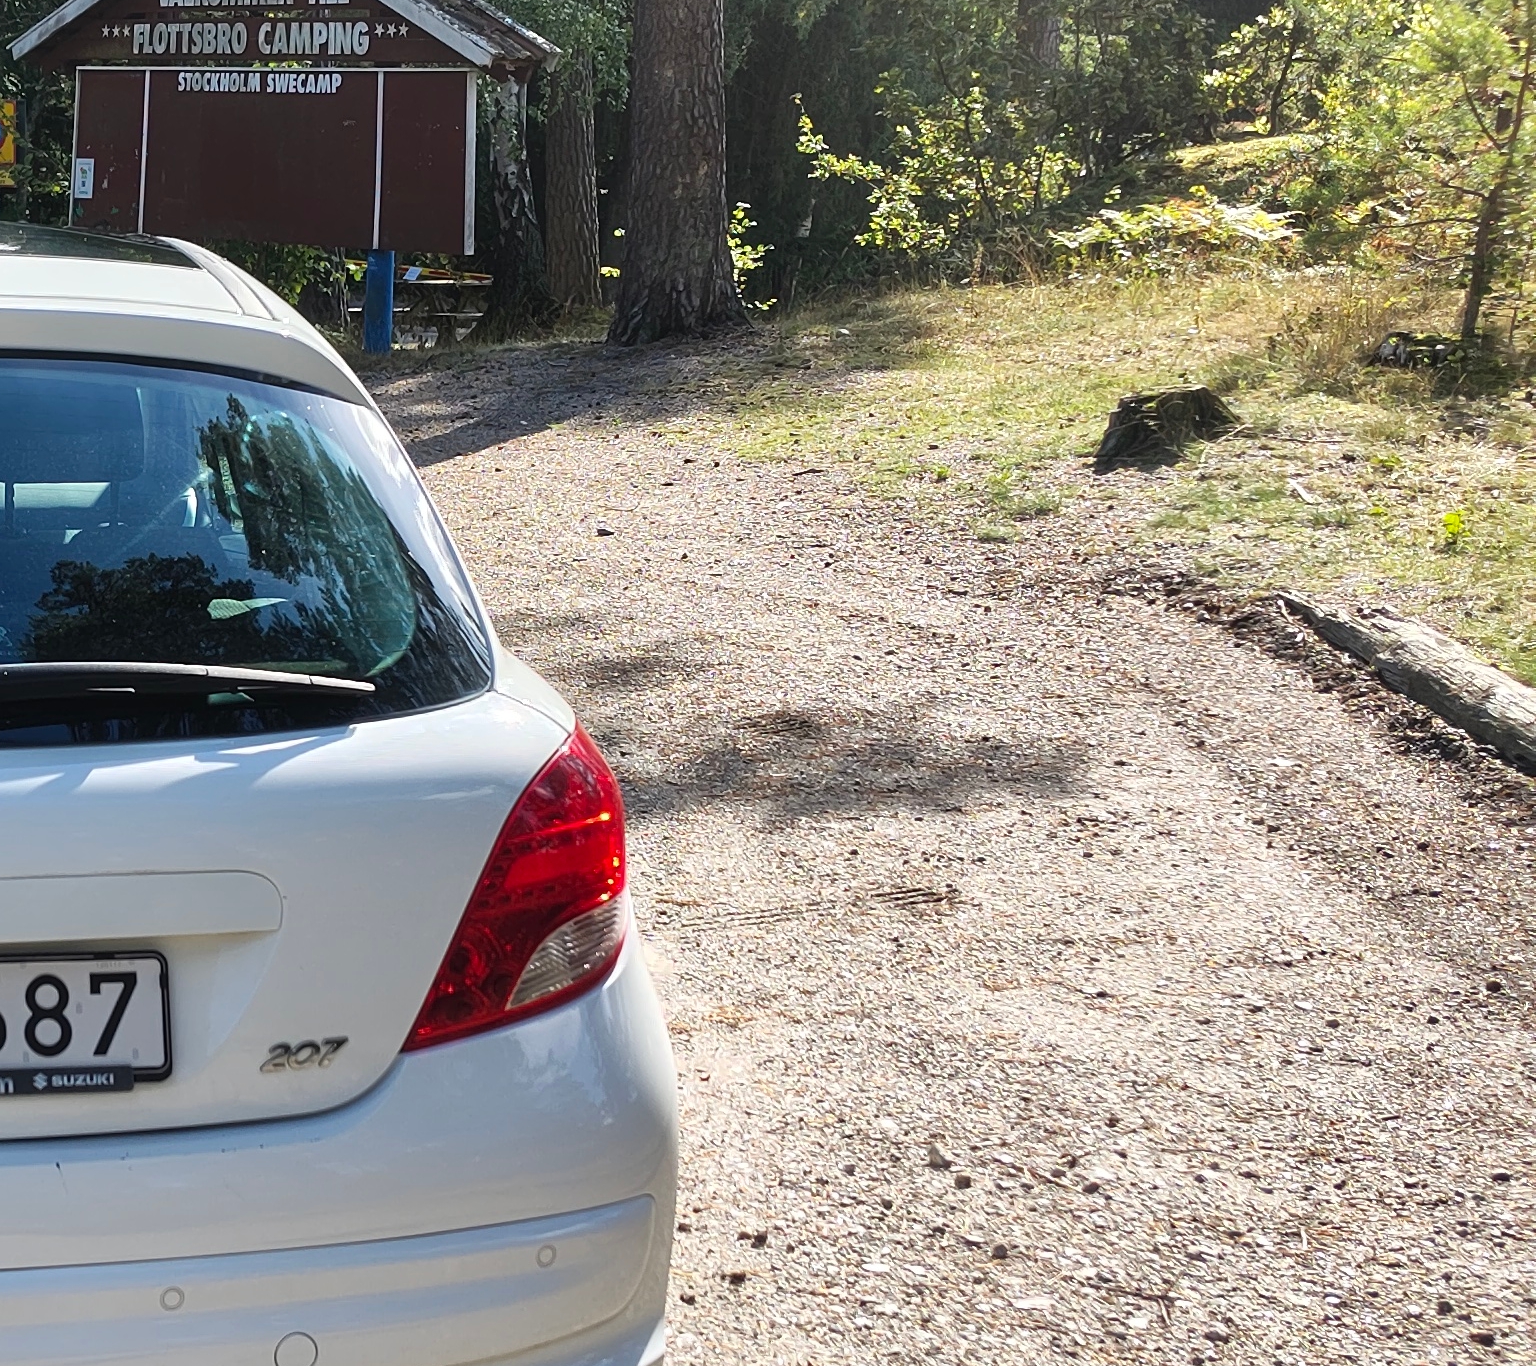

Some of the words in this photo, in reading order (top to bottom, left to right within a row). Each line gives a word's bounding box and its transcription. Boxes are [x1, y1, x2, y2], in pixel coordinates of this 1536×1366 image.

[132, 22, 248, 55] FLOTTSBRO
[258, 21, 370, 55] CAMPING
[177, 71, 261, 93] STOCKHOLM
[266, 73, 343, 94] SWECAMP
[259, 1035, 349, 1073] 207
[51, 1072, 114, 1087] SUZUKI
